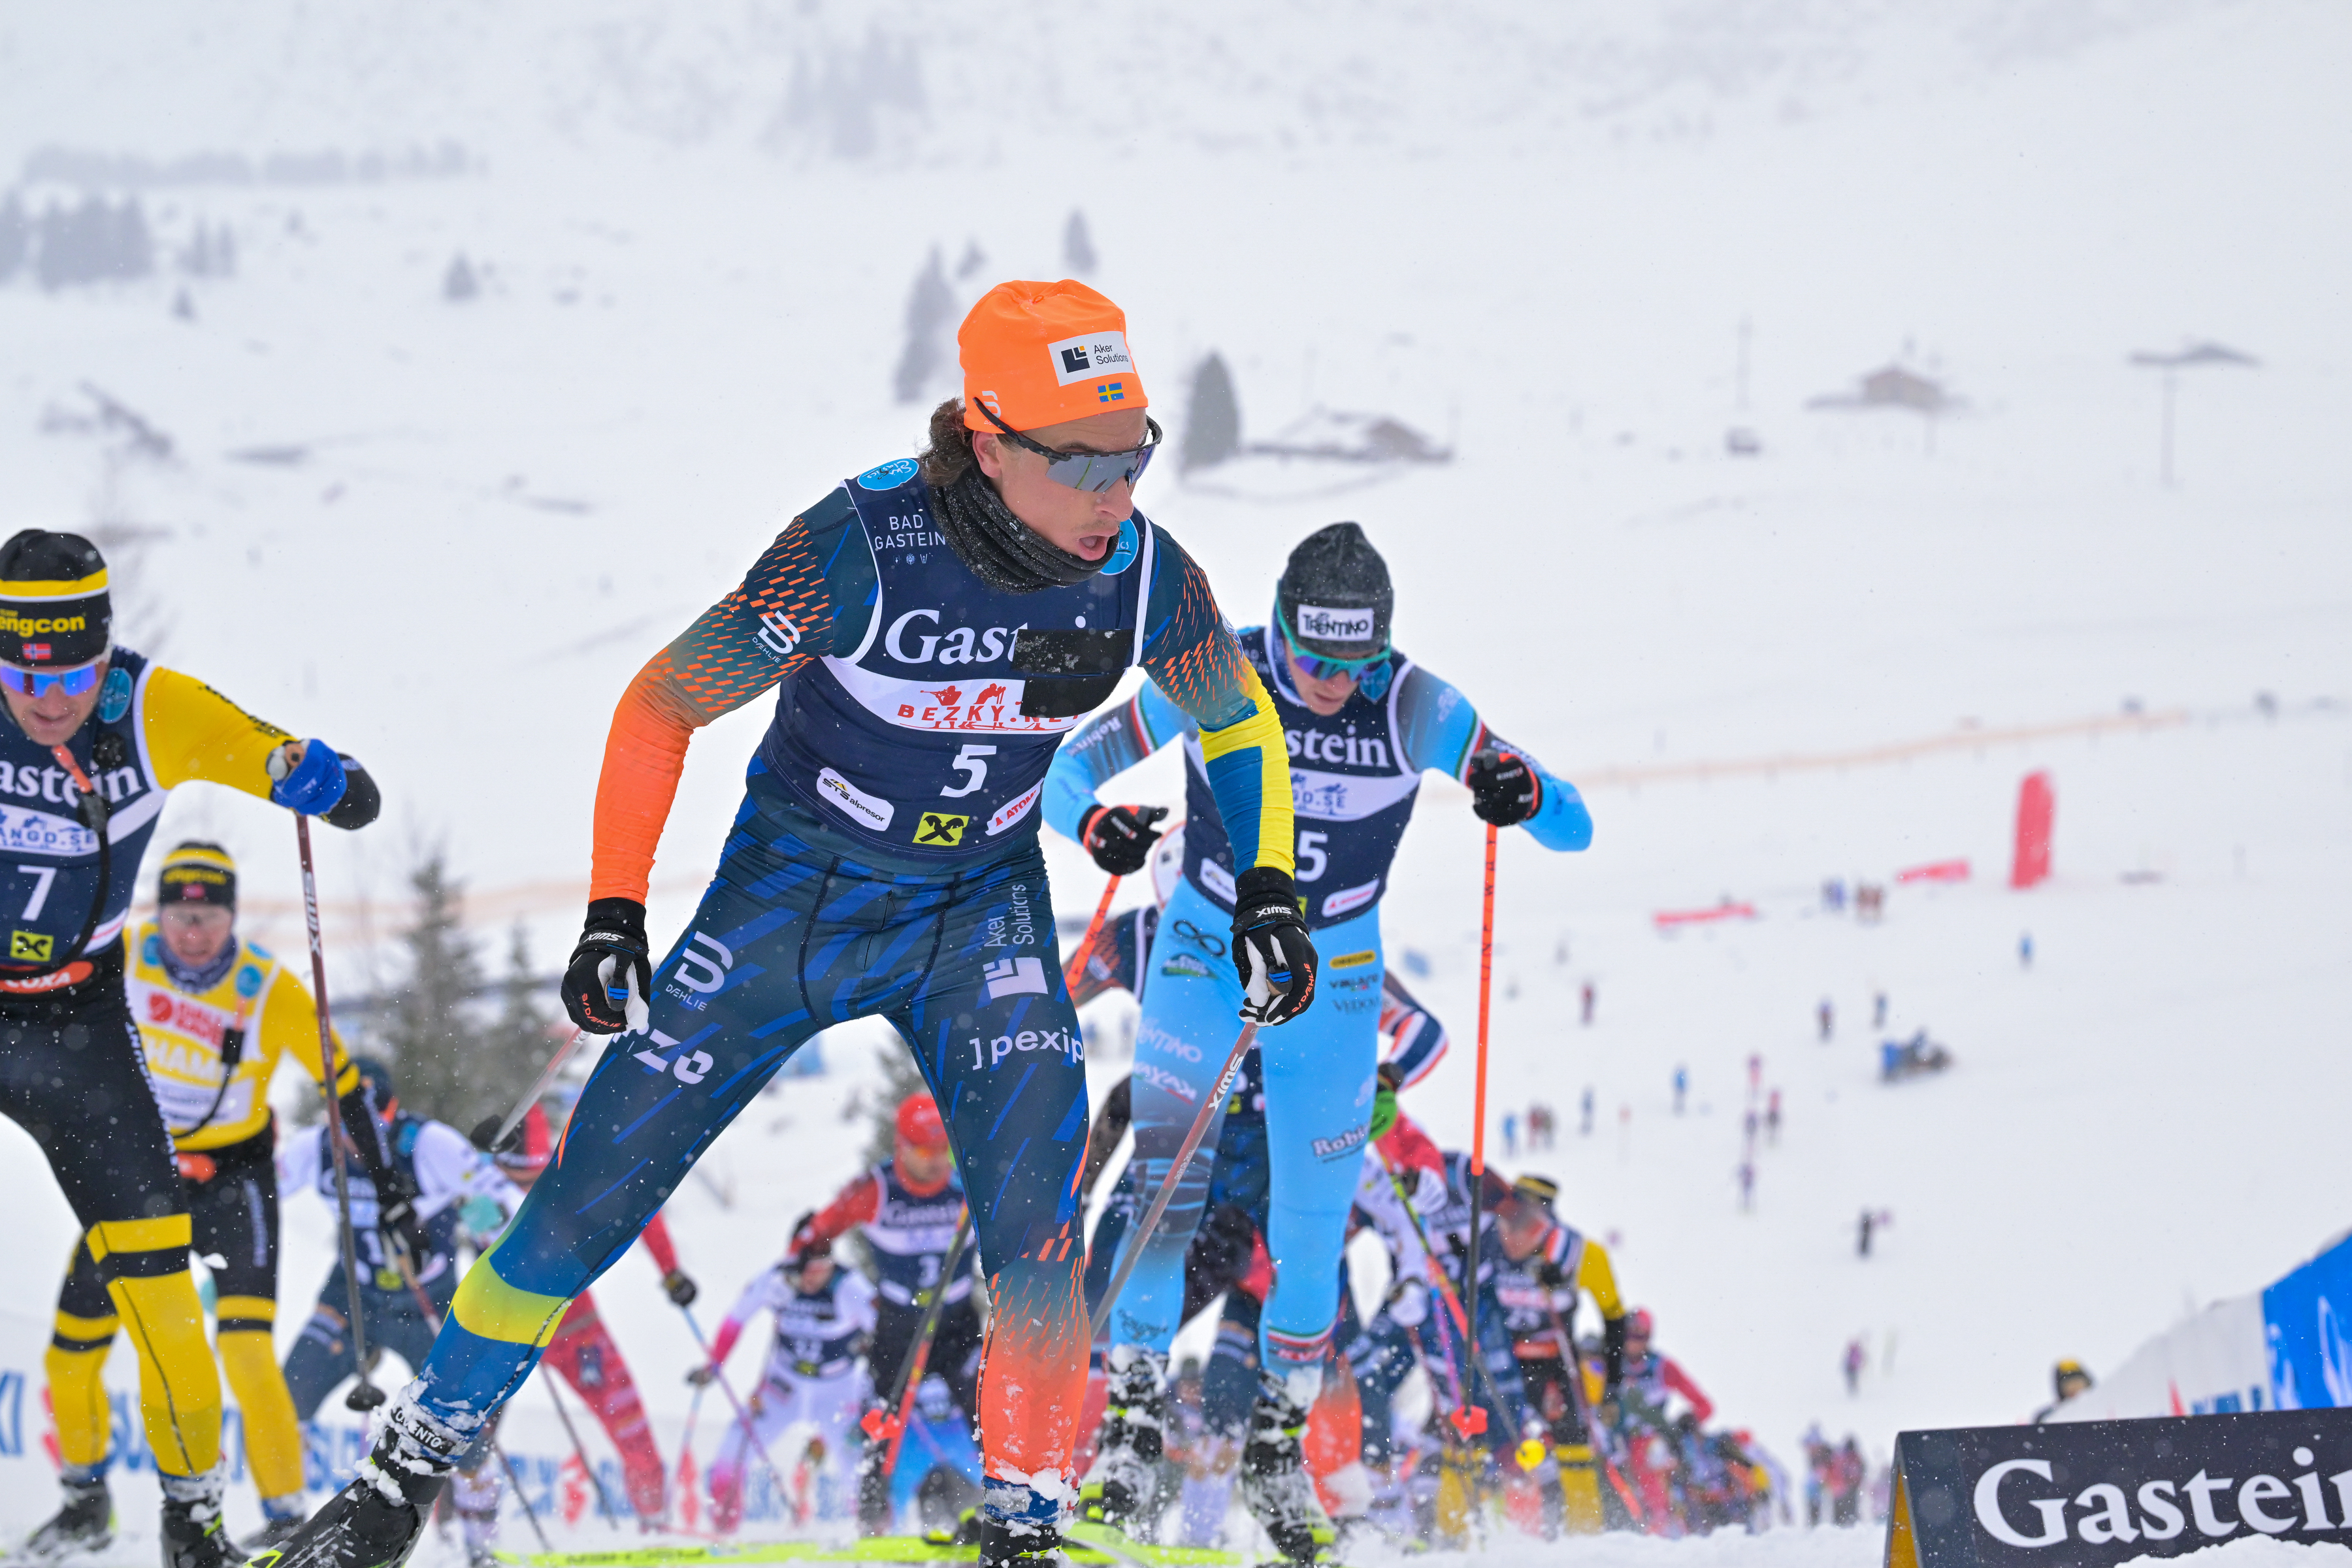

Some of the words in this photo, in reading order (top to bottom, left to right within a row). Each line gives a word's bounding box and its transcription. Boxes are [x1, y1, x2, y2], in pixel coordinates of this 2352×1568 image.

[1094, 344, 1113, 354] Aker
[1096, 353, 1129, 365] Solutions
[874, 531, 947, 550] GASTEIN
[889, 514, 924, 531] BAD
[1284, 724, 1391, 768] stein
[939, 744, 997, 798] 5
[823, 778, 850, 800] STS
[849, 798, 885, 822] alpresor
[18, 864, 57, 922] 7
[984, 916, 1007, 947] Aker
[1011, 884, 1035, 945] Solutions
